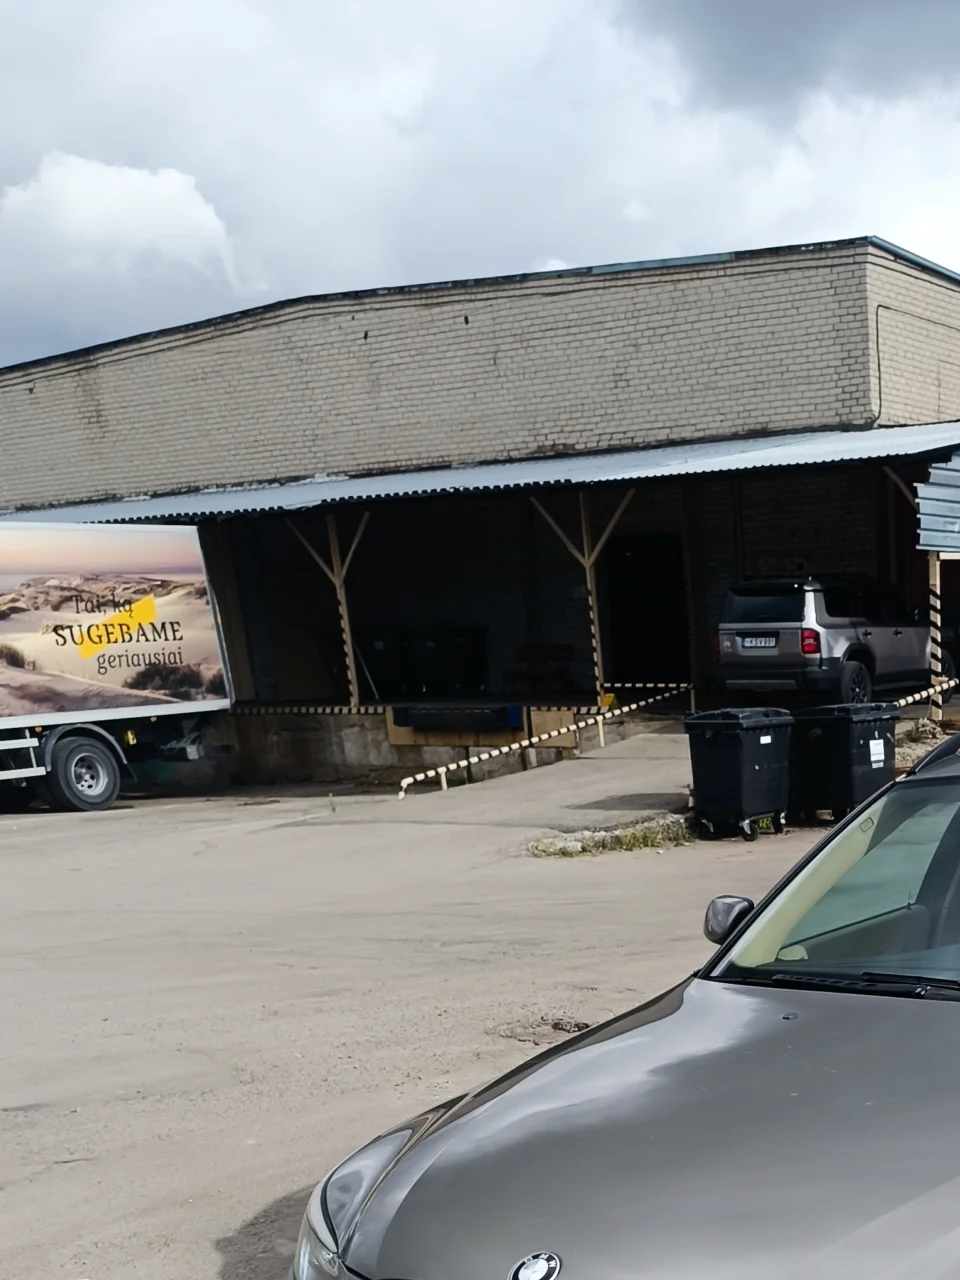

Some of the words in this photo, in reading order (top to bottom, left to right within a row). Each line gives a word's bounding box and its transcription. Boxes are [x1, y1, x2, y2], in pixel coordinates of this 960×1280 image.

[72, 594, 107, 616] Tai,
[112, 593, 134, 618] ką
[54, 621, 183, 647] SUGEBAME
[97, 647, 183, 675] geriausiai
